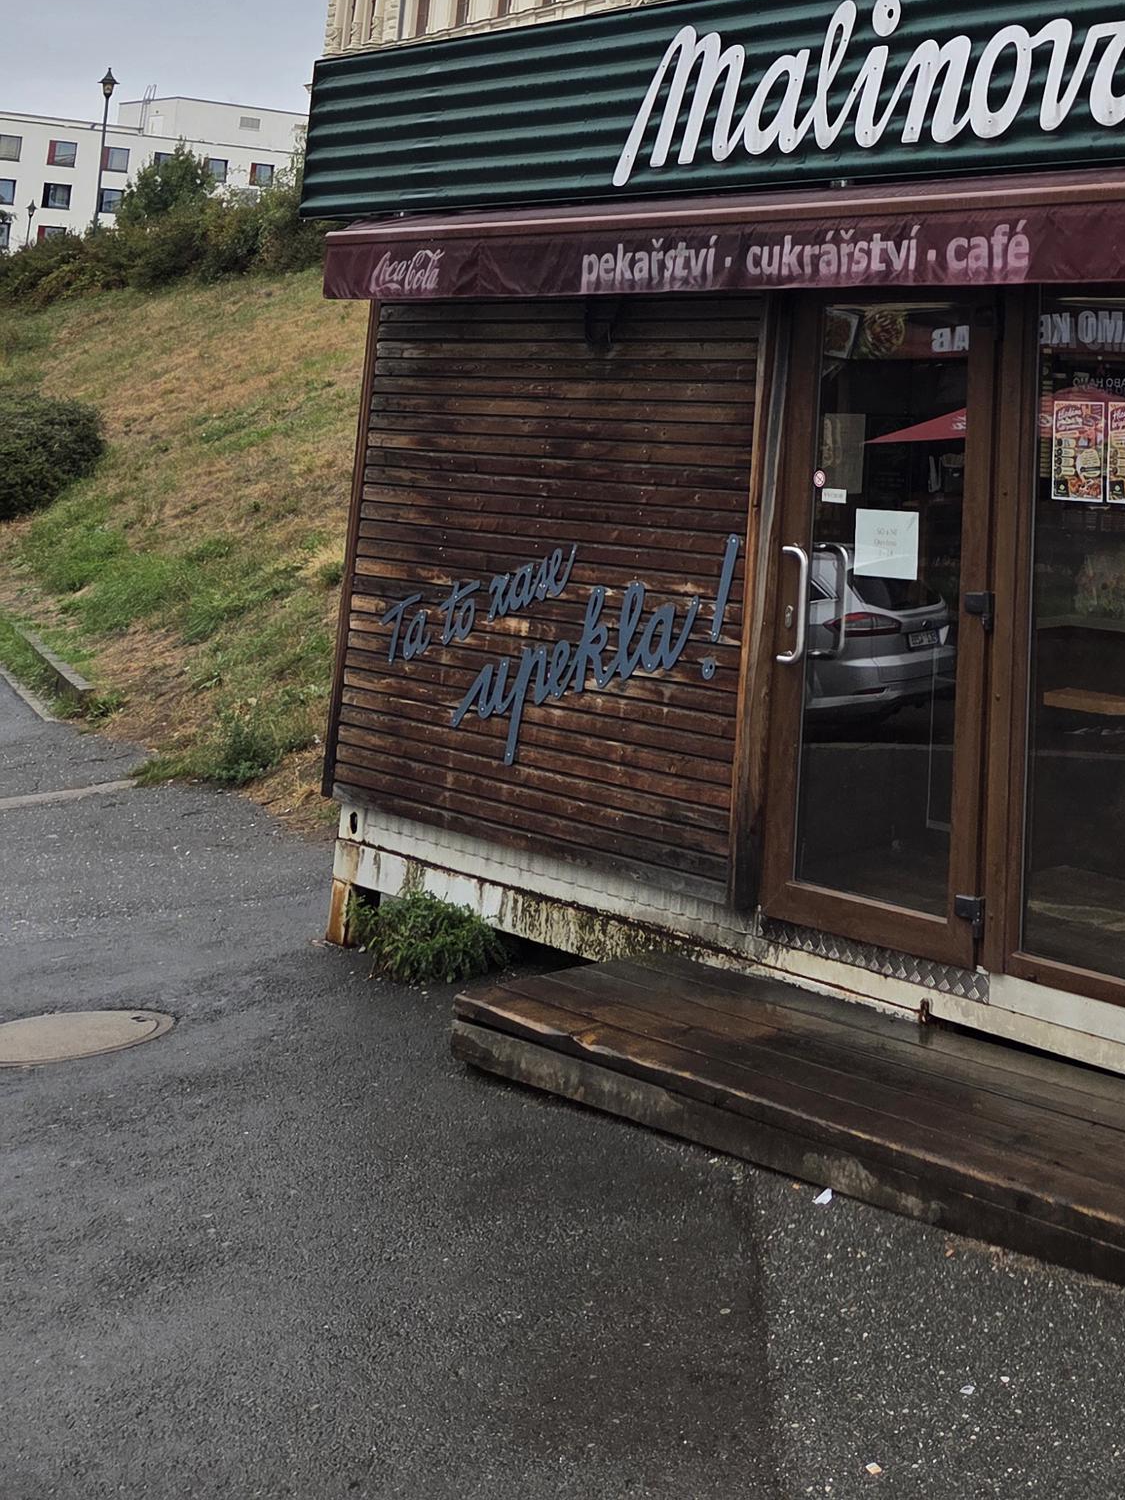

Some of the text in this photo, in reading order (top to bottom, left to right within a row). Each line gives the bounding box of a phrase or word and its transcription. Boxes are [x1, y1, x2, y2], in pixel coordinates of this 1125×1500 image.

[368, 249, 445, 293] Coca-Cola
[581, 219, 1031, 291] pekařství cukrářství café
[379, 591, 431, 664] Ta
[438, 580, 481, 646] to
